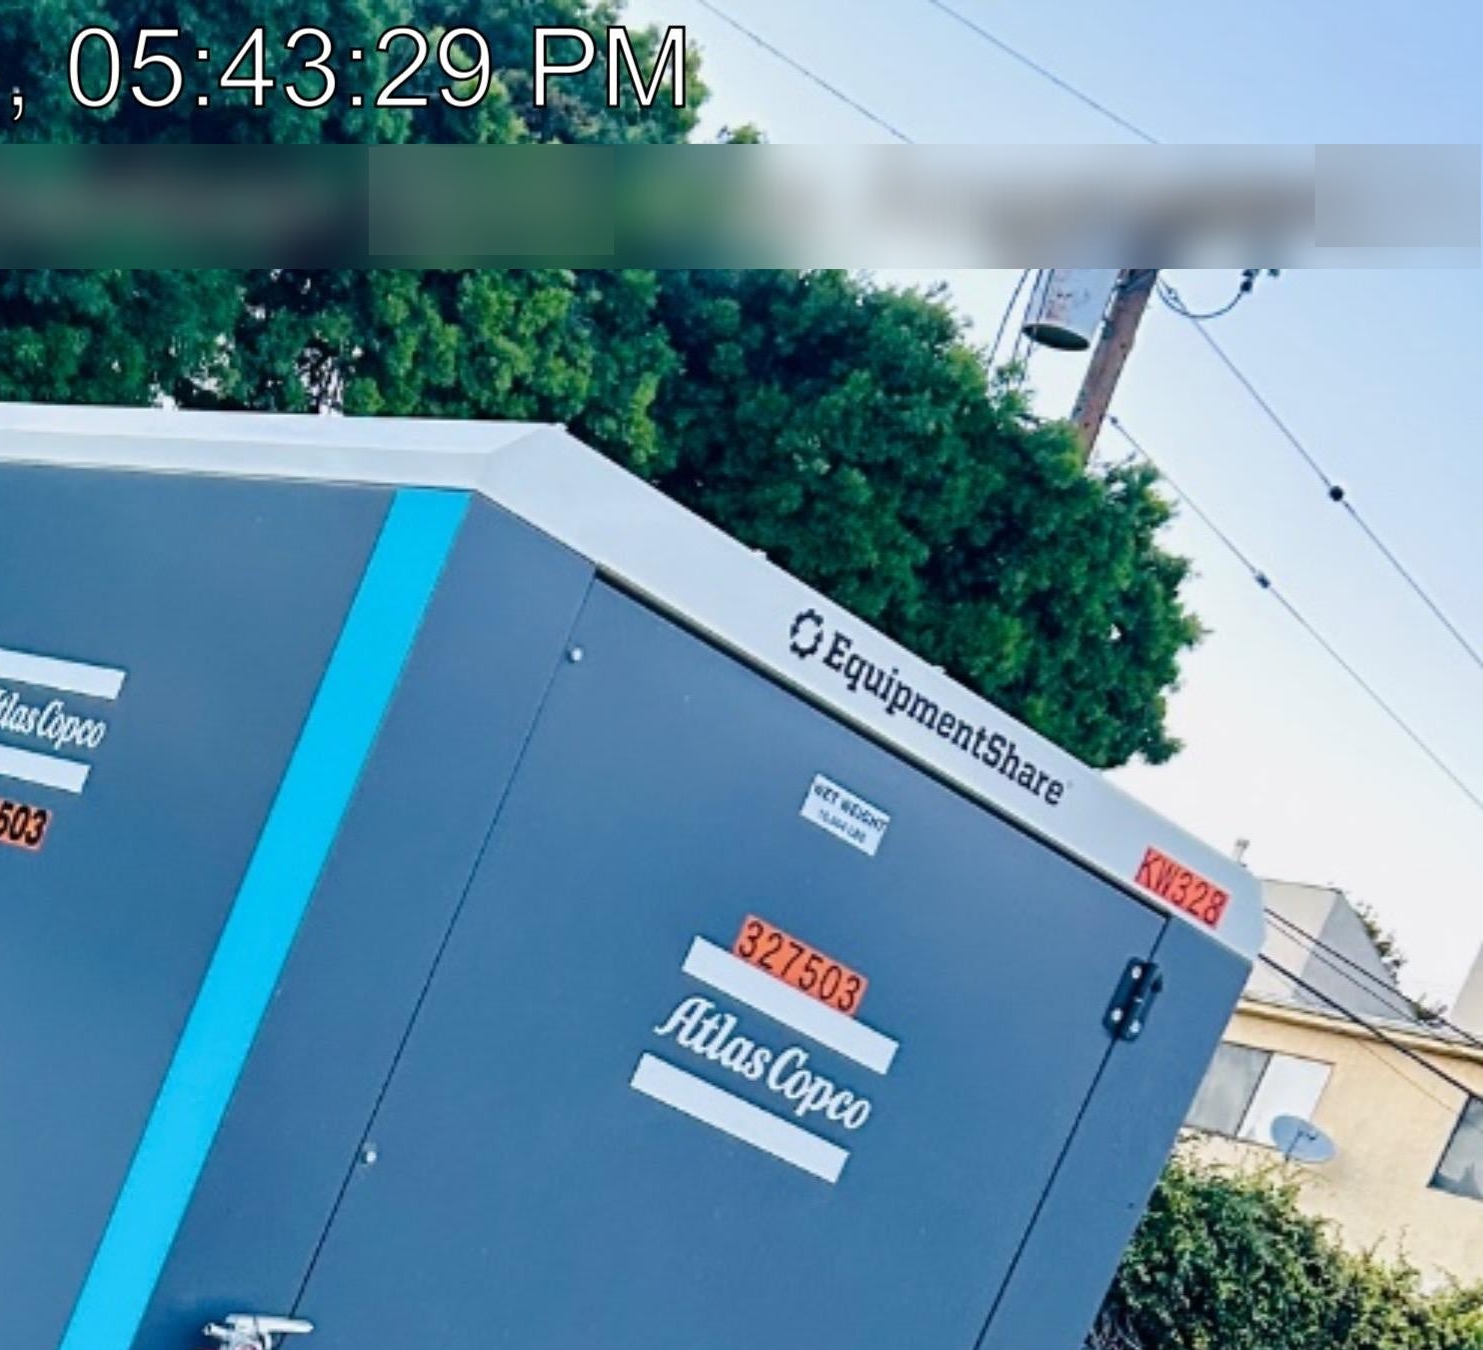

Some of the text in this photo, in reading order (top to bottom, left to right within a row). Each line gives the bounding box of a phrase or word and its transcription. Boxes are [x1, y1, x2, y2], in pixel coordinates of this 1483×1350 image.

[822, 630, 1065, 806] EquipmentShare
[1138, 853, 1227, 926] KW328
[738, 920, 862, 1012] 327503
